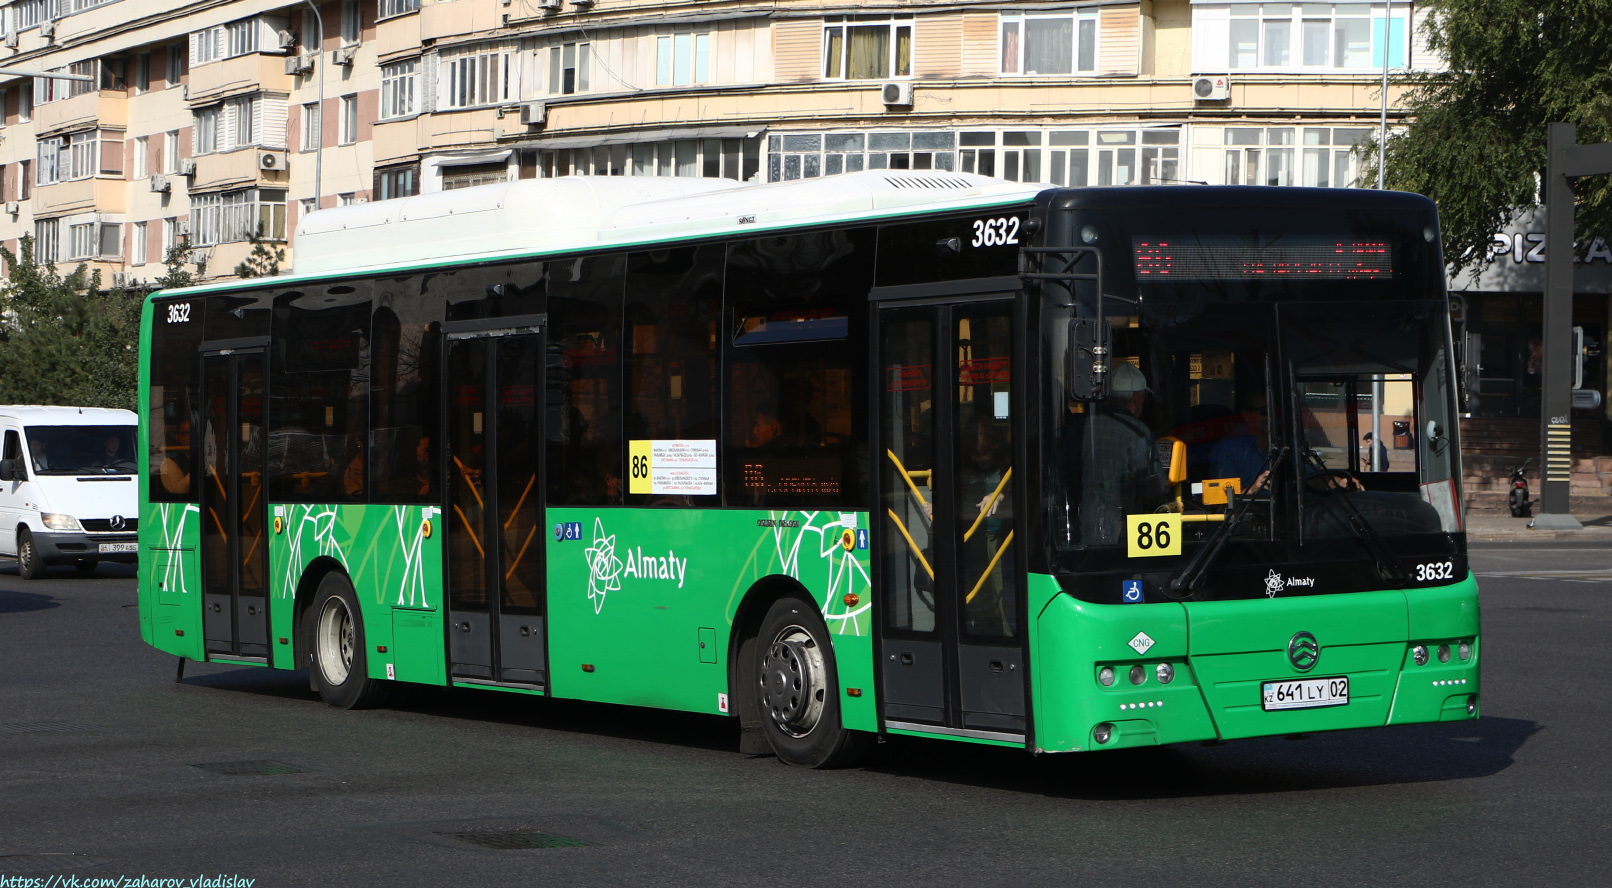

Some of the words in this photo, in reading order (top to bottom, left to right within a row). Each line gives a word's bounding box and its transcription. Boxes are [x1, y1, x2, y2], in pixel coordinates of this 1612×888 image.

[972, 216, 1019, 247] 3632
[1488, 233, 1612, 263] PIZA
[167, 303, 190, 323] 3632
[632, 455, 648, 478] 86
[757, 519, 776, 528] GOLDEN
[779, 520, 799, 529] DRAGON
[1137, 521, 1171, 549] 86
[624, 546, 687, 588] Almaty
[1416, 561, 1454, 581] 3632
[1286, 577, 1315, 588] Almaty
[1133, 638, 1150, 647] CNG
[1264, 695, 1273, 703] KZ
[1277, 683, 1302, 701] 641
[1307, 685, 1324, 699] LY
[1330, 680, 1347, 697] 02
